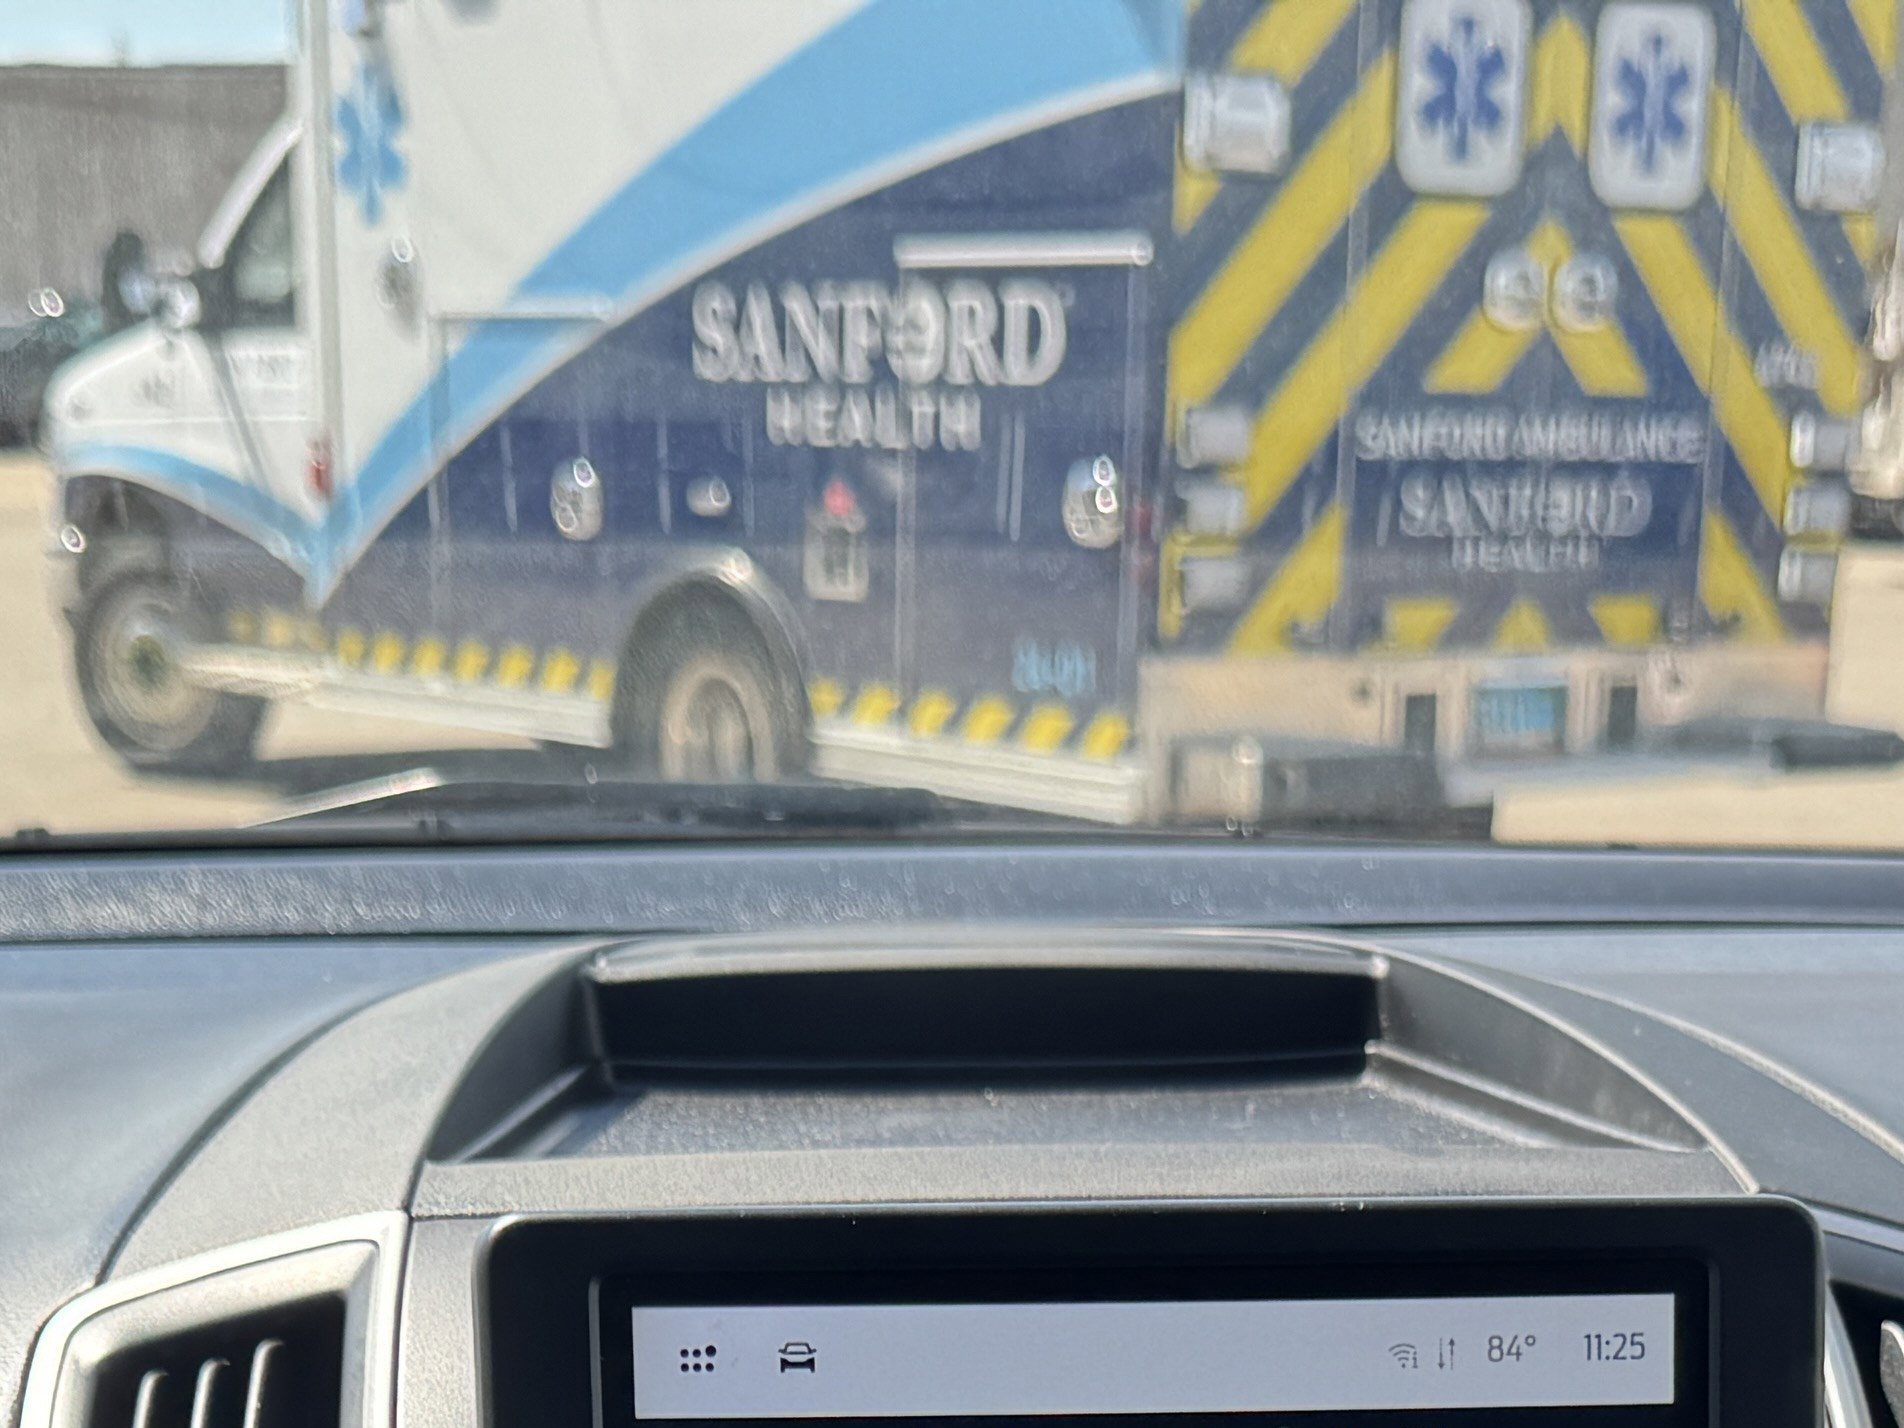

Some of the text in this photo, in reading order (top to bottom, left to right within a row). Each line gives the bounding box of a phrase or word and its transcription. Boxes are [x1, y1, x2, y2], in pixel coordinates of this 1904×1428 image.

[693, 279, 1066, 387] SANFORD
[766, 385, 981, 450] HEALTH
[1487, 1333, 1645, 1362] 84° 11:25
